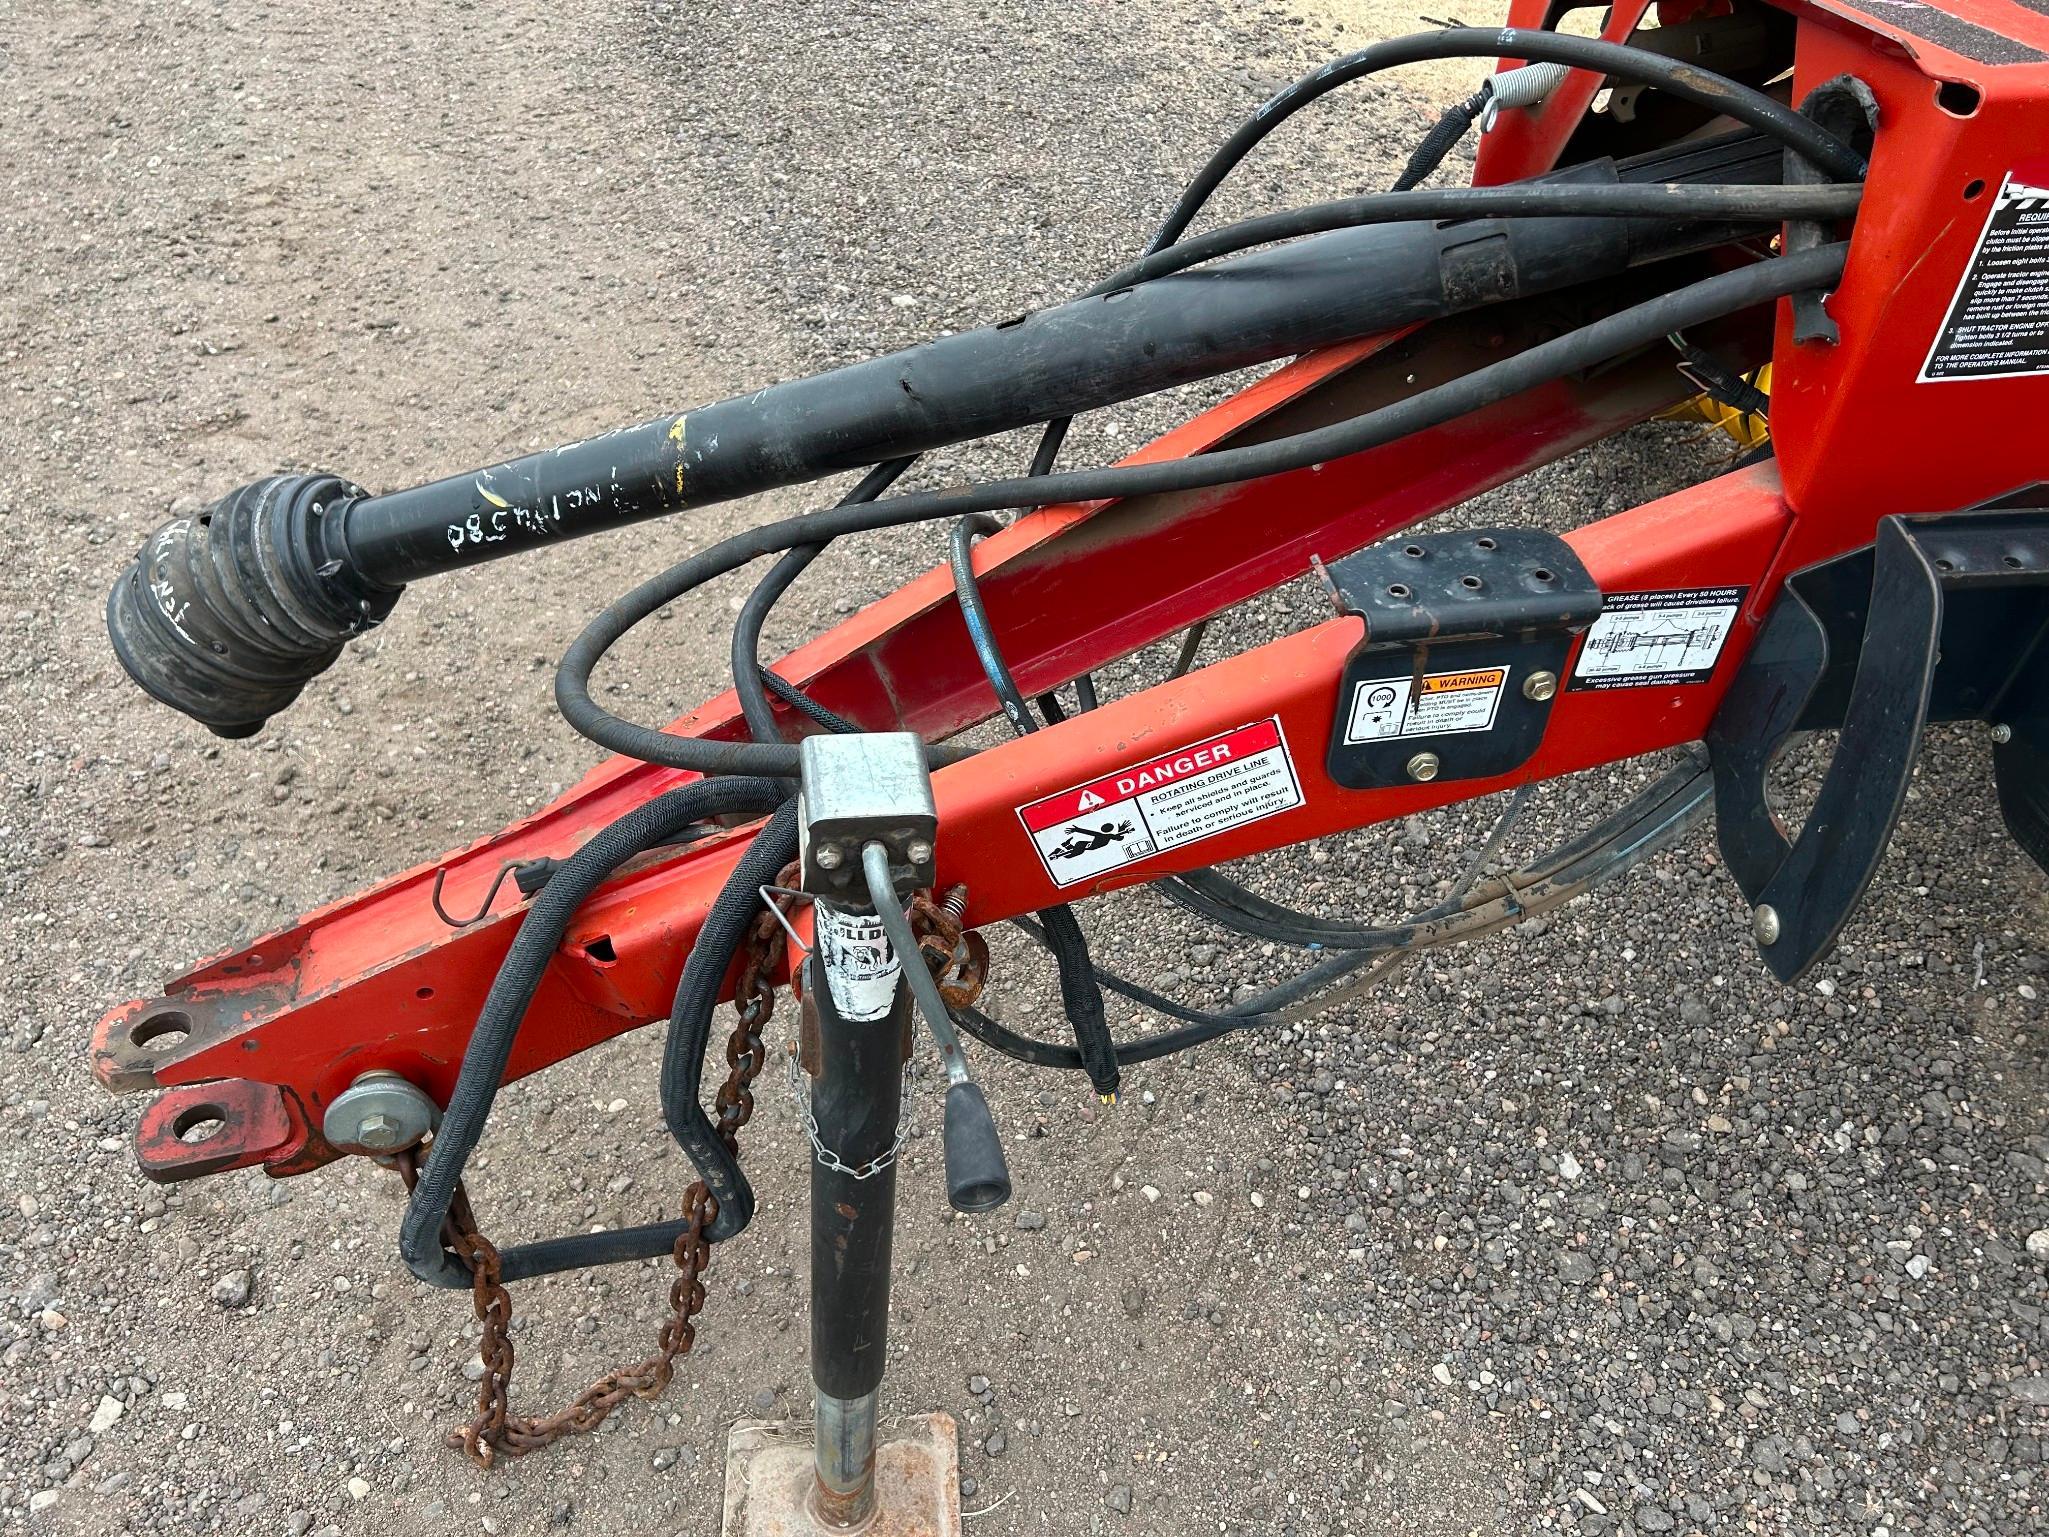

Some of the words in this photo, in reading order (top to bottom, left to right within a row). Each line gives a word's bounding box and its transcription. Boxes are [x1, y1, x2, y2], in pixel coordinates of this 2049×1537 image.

[1957, 325, 1976, 333] SHUT
[1977, 323, 2008, 332] TRACTOR
[2004, 349, 2047, 357] INFORMATION
[1649, 593, 1676, 601] places)
[1372, 694, 1392, 702] 1000
[1440, 675, 1496, 688] WARNING
[1116, 743, 1232, 795] DANGER
[1151, 779, 1205, 804] ROTATING
[1208, 767, 1240, 783] DRIVE
[1243, 757, 1269, 771] LINE
[1159, 801, 1183, 815] Keep
[1184, 797, 1195, 806] all
[1197, 786, 1229, 802] shields
[1231, 780, 1248, 790] and
[1250, 768, 1281, 785] guards
[1175, 800, 1213, 818] serviced
[1215, 793, 1232, 804] and
[1233, 789, 1242, 798] in
[1244, 782, 1270, 795] place.
[1155, 821, 1190, 837] Failure
[1192, 815, 1201, 824] to
[1203, 804, 1239, 820] comply
[1241, 796, 1259, 807] will
[1260, 786, 1290, 800] result
[1164, 835, 1173, 843] in
[1173, 826, 1203, 841] death
[1217, 808, 1254, 824] serious
[1255, 797, 1287, 812] injury.
